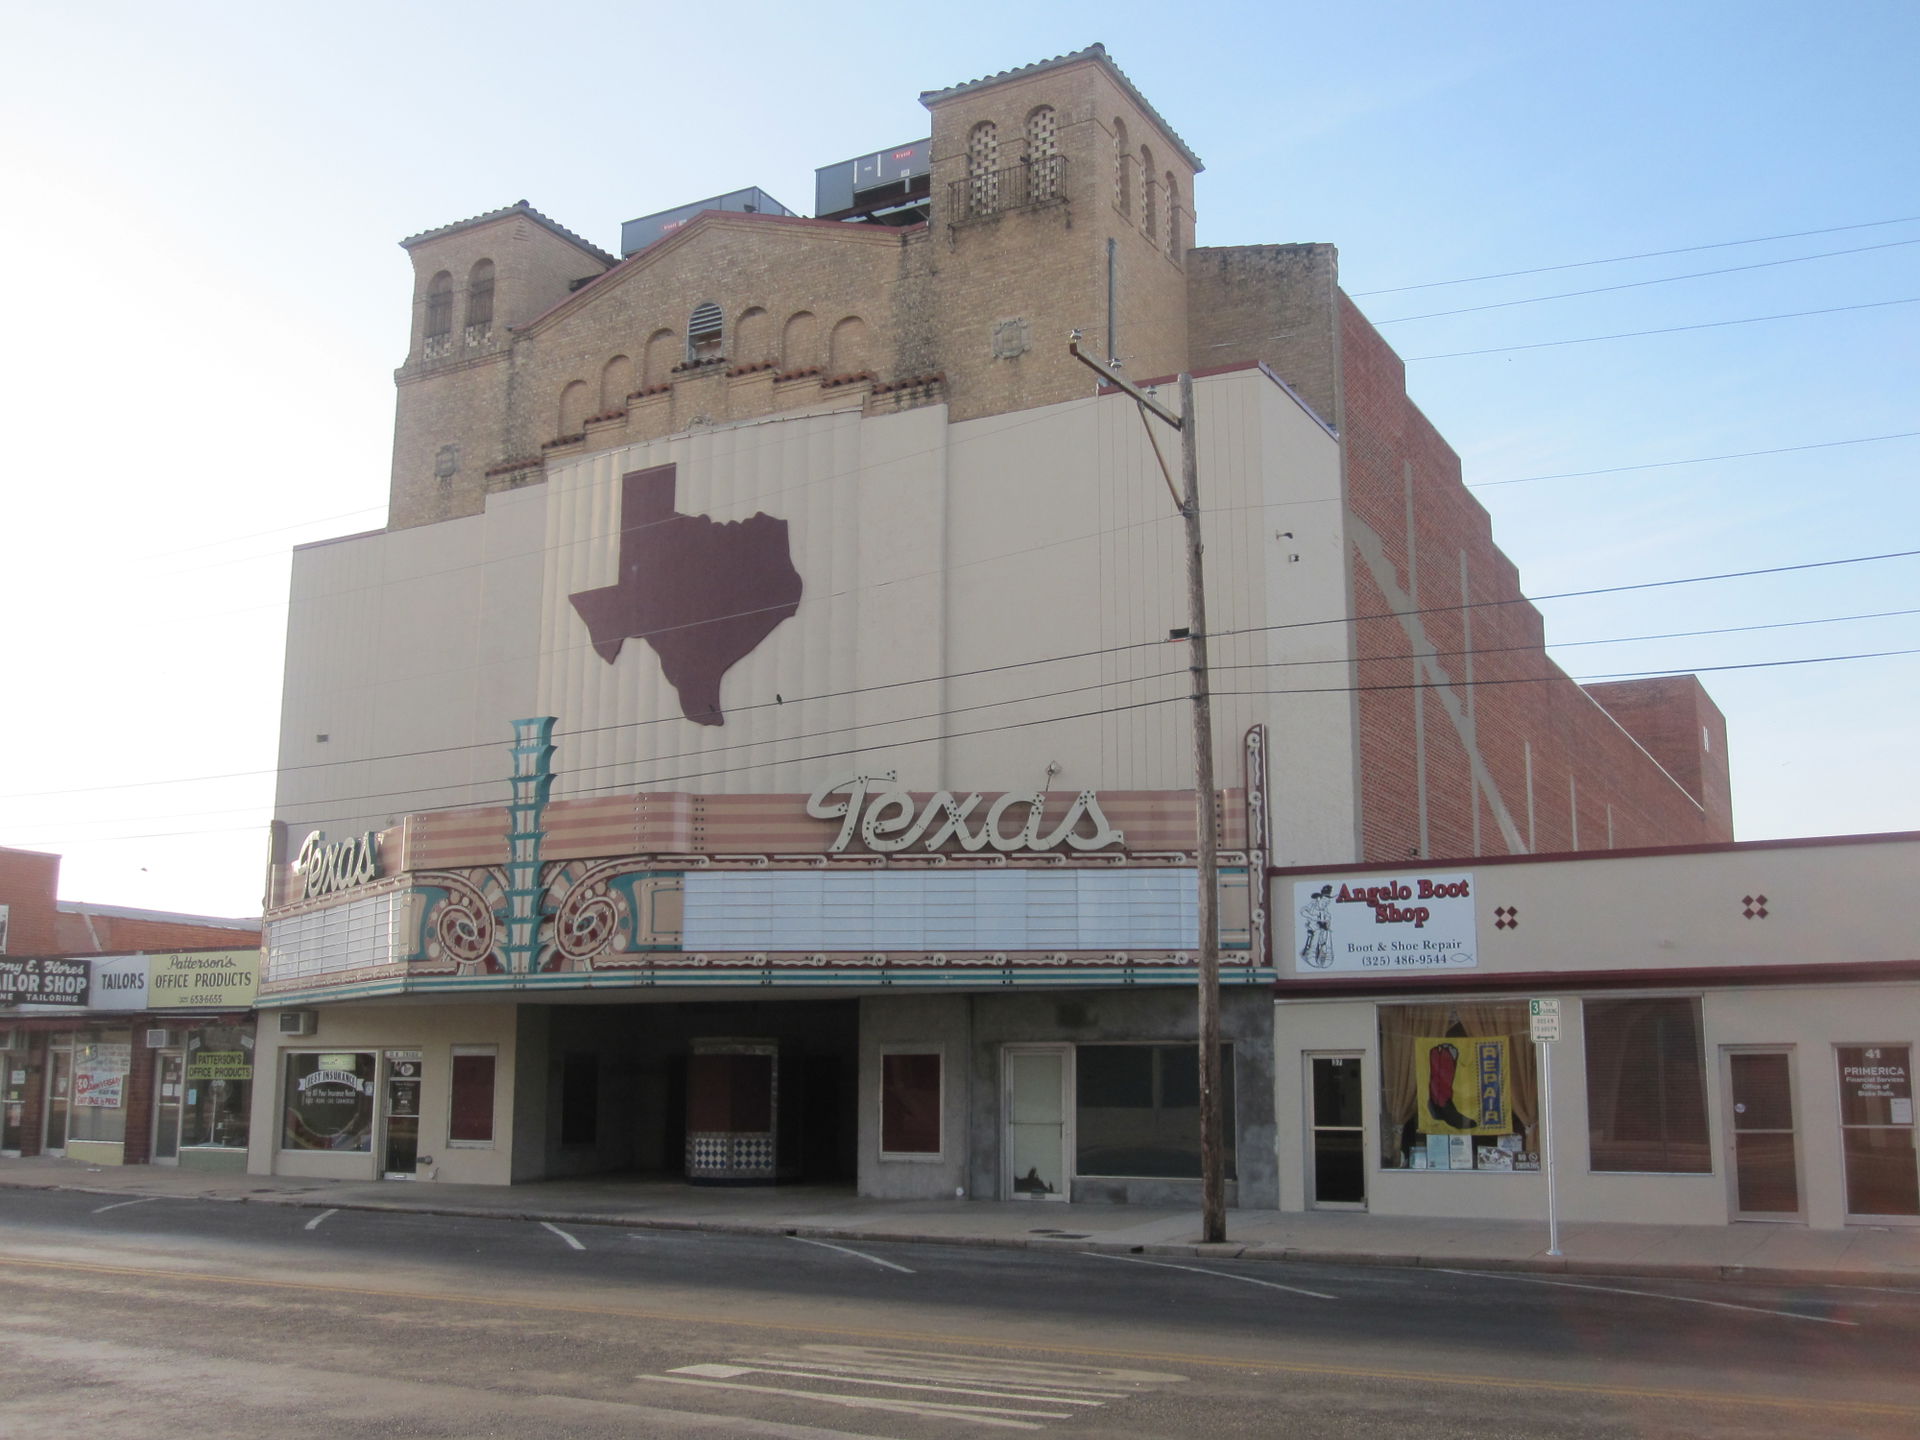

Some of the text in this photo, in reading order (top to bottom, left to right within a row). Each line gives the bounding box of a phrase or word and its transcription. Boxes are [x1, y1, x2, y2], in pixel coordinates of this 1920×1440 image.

[806, 769, 1125, 852] Texas
[291, 829, 377, 900] Texas
[1335, 878, 1470, 908] Angelo Boot
[1375, 903, 1430, 928] Shop
[1347, 938, 1463, 953] Boot & Shoe Repair
[26, 959, 40, 973] E.
[44, 960, 85, 975] Flores
[167, 954, 237, 971] Patterson's
[1361, 954, 1447, 967] (325) 486-9544
[44, 975, 88, 994] SHOP
[102, 972, 145, 990] TAILORS
[155, 971, 252, 989] OFFICE PRODUCTS
[26, 993, 79, 1003] TAILORING
[1532, 1001, 1540, 1015] 3
[197, 1054, 243, 1065] PATTERSON'S
[1865, 1048, 1881, 1059] 41
[189, 1066, 251, 1078] OFFICE PRODUCTS
[307, 1070, 356, 1086] BEST INSURANCE
[1844, 1066, 1905, 1076] PRIMERICA
[1481, 1047, 1499, 1122] REPAIR
